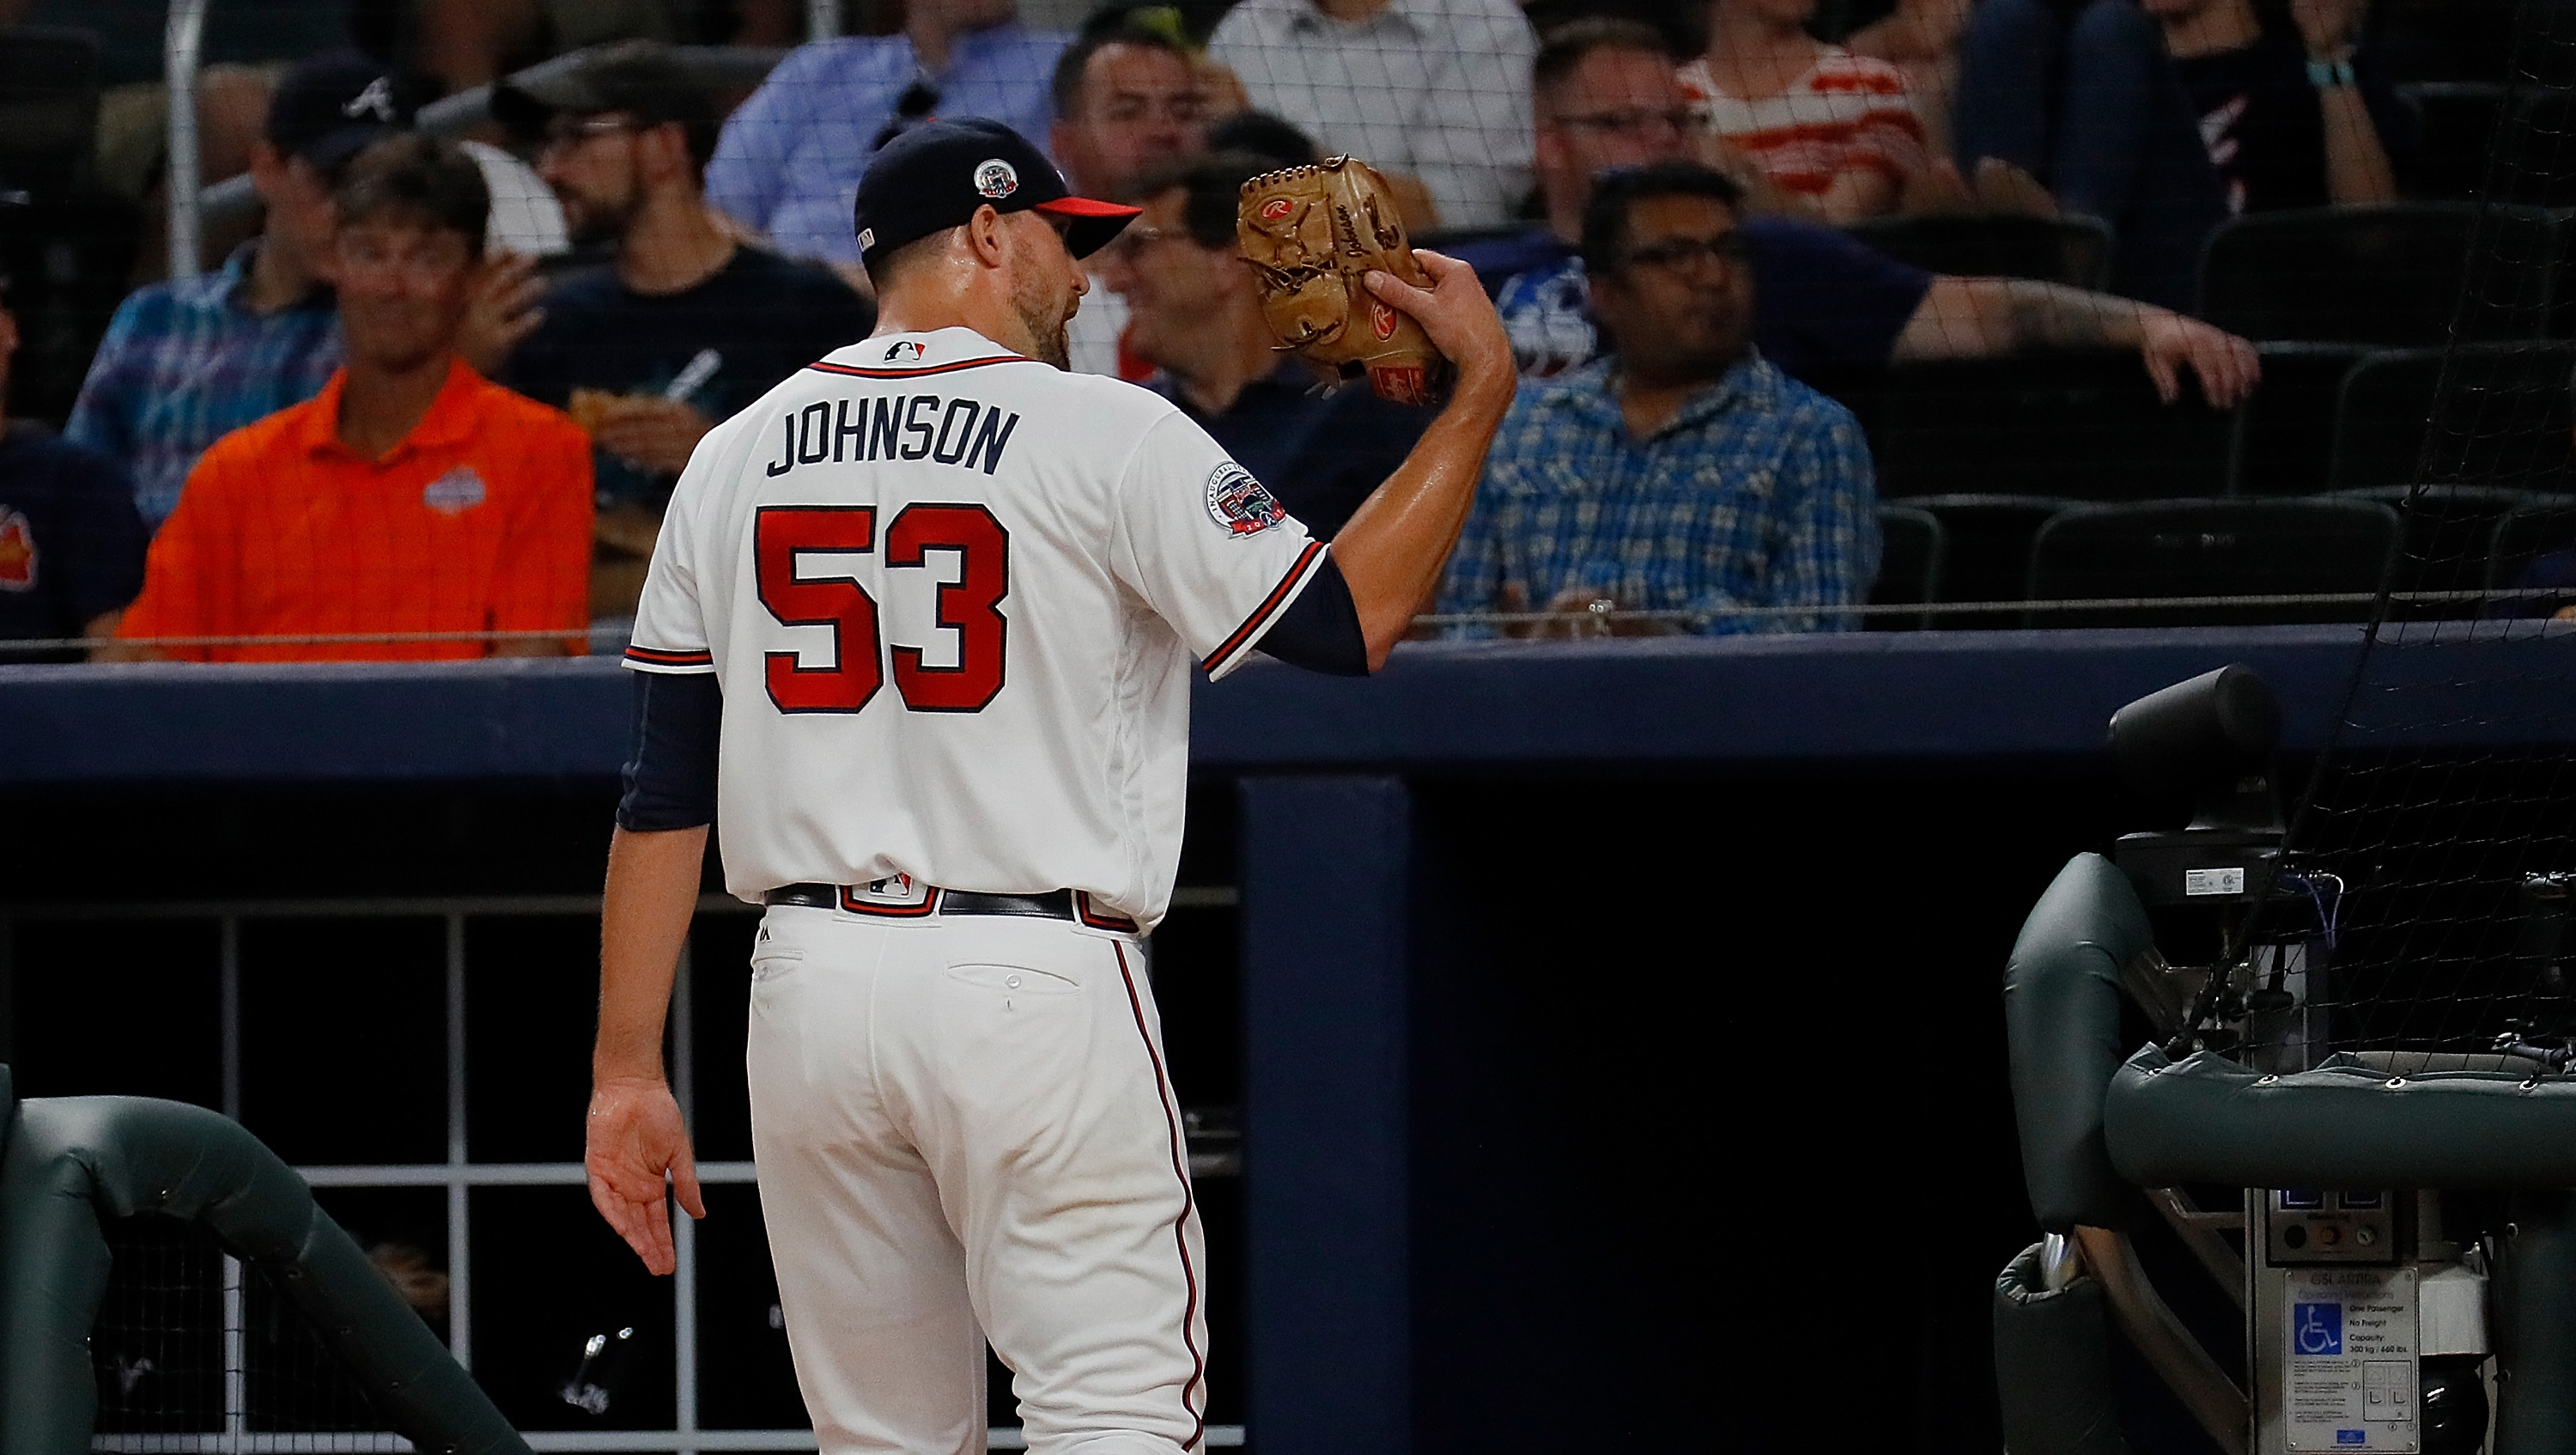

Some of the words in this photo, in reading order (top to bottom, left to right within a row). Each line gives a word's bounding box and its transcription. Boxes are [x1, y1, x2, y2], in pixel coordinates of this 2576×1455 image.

[766, 395, 1020, 478] JOHNSON
[1208, 464, 1232, 513] INAUGURAL
[754, 502, 1010, 715] 53
[2362, 1319, 2386, 1328] Freight
[2367, 1305, 2404, 1314] Passenger
[2365, 1345, 2375, 1355] kg
